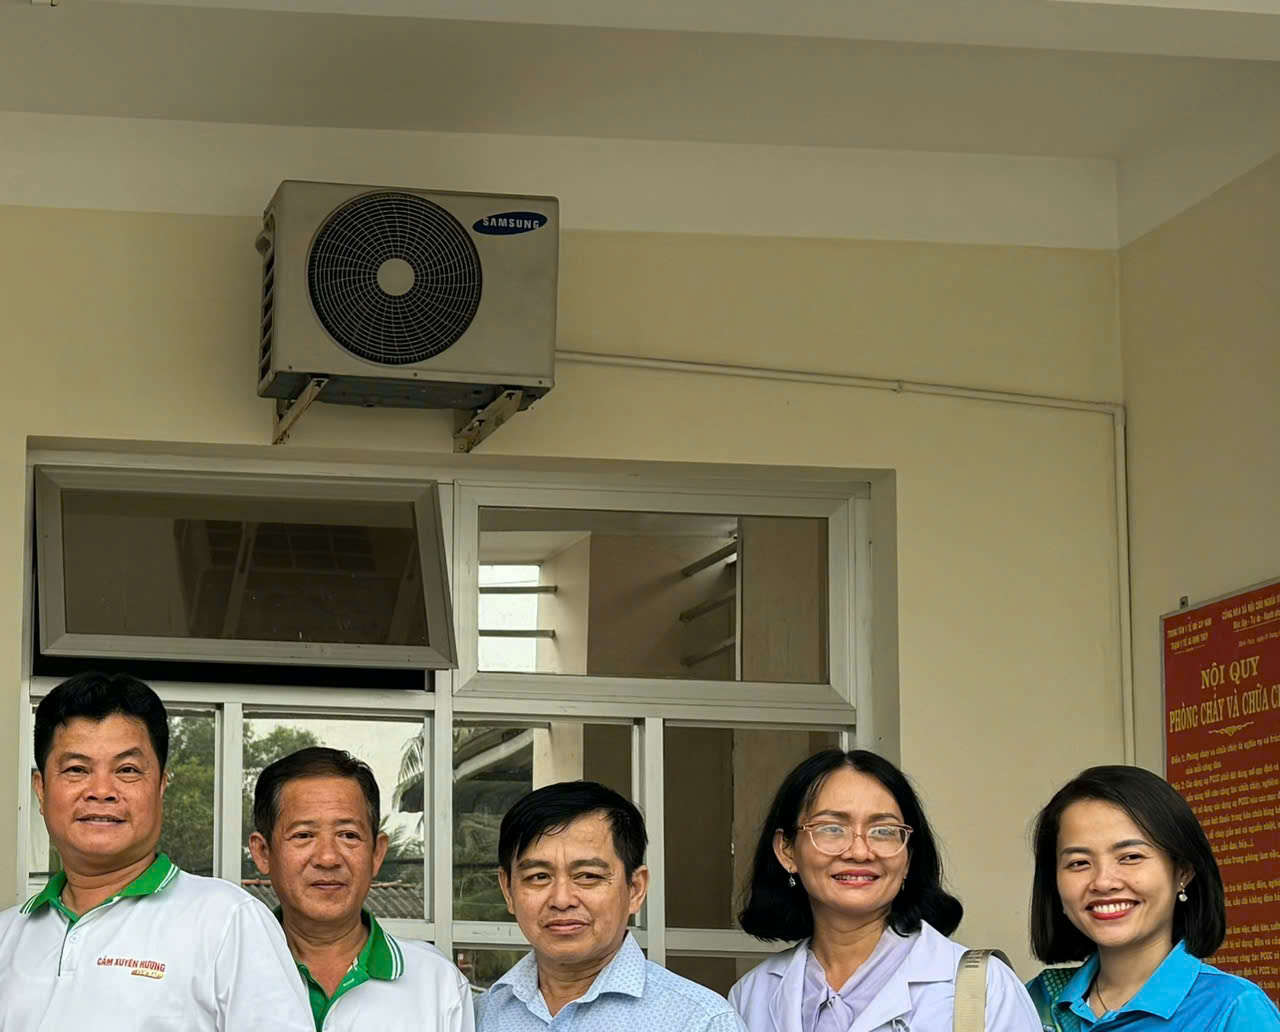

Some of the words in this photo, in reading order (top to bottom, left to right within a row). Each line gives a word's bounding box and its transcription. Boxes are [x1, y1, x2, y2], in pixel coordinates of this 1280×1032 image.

[482, 216, 540, 230] SAMSUNG
[1201, 662, 1224, 690] NỘI
[1230, 656, 1260, 685] QUY
[1170, 701, 1198, 733] PHÒNG
[1200, 693, 1224, 726] CHÁY
[1226, 688, 1240, 719] VÀ
[1242, 683, 1269, 716] CHỮA
[114, 958, 138, 968] XUYÊN
